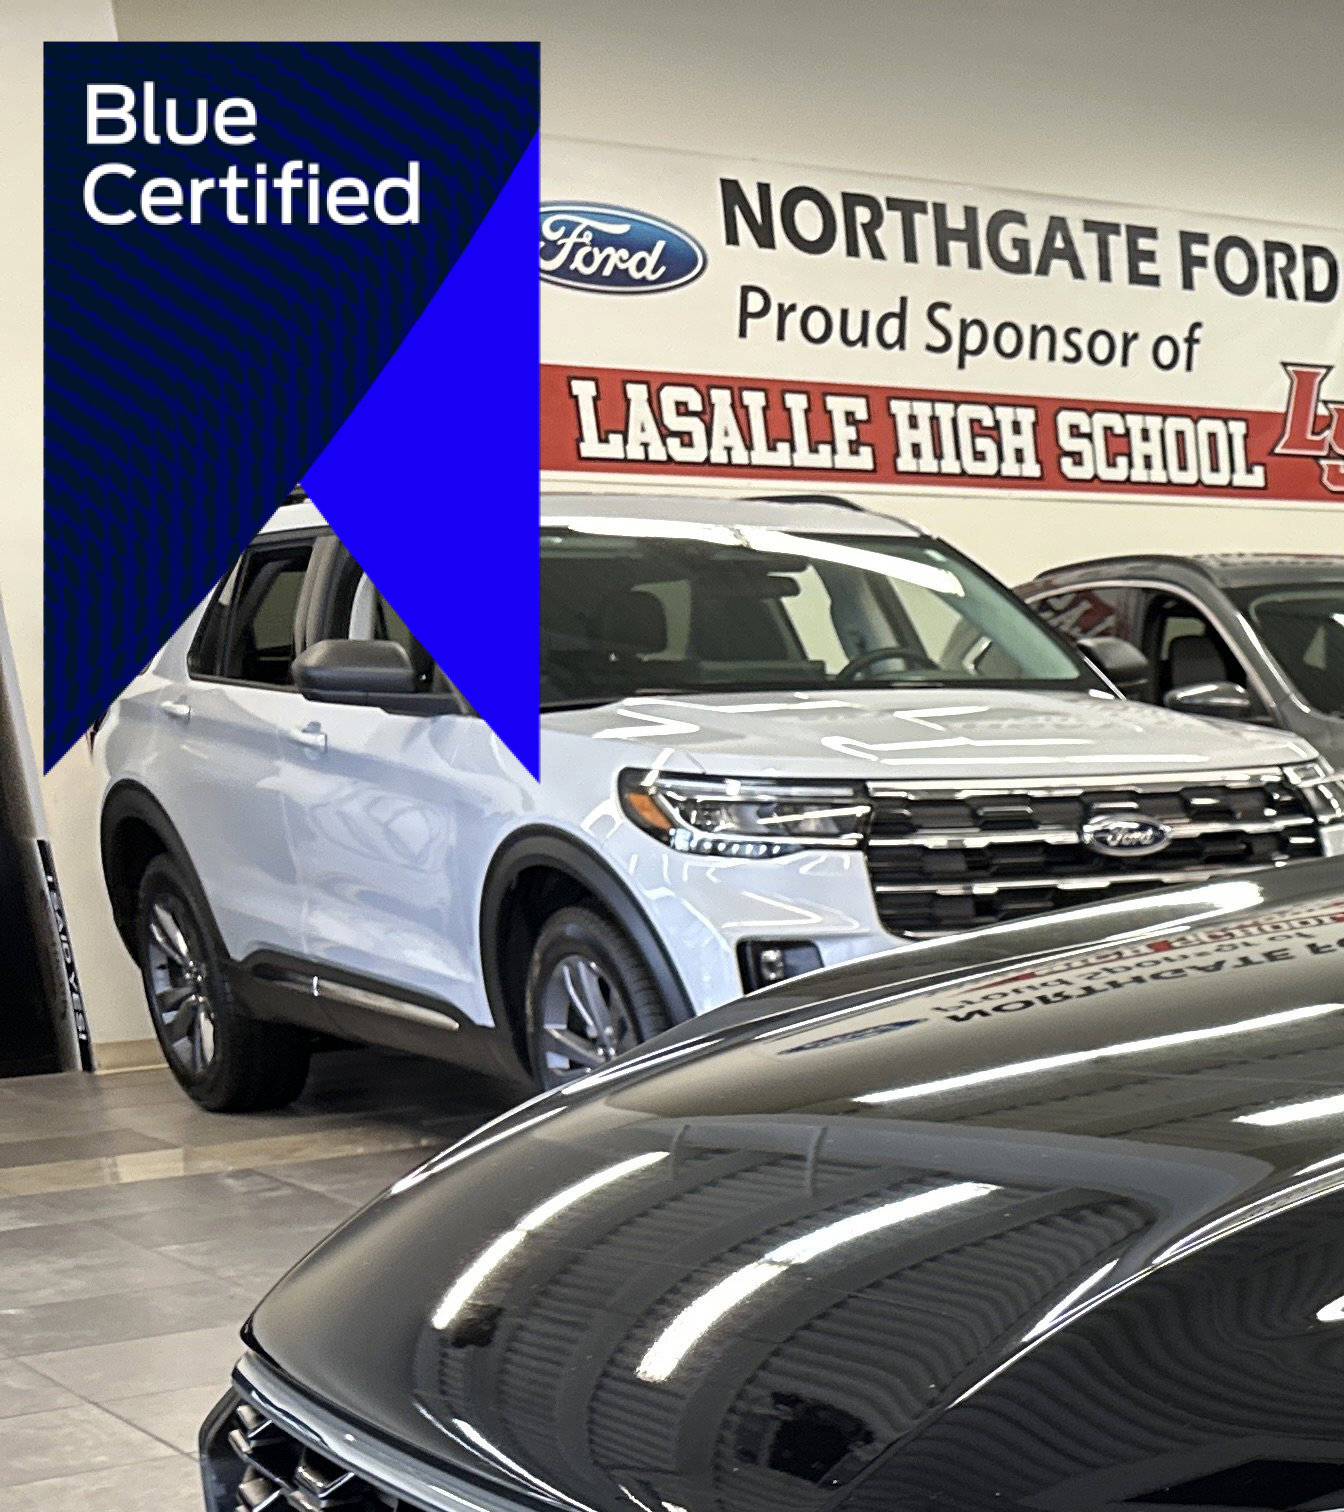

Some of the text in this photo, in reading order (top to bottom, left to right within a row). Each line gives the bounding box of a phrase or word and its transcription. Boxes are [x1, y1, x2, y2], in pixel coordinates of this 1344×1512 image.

[540, 213, 666, 283] Ford
[719, 177, 1341, 305] NORTHGATE FORD
[737, 285, 1203, 374] Proud Sponsor of
[567, 376, 1268, 492] LASALLE HIGH SCHOOL
